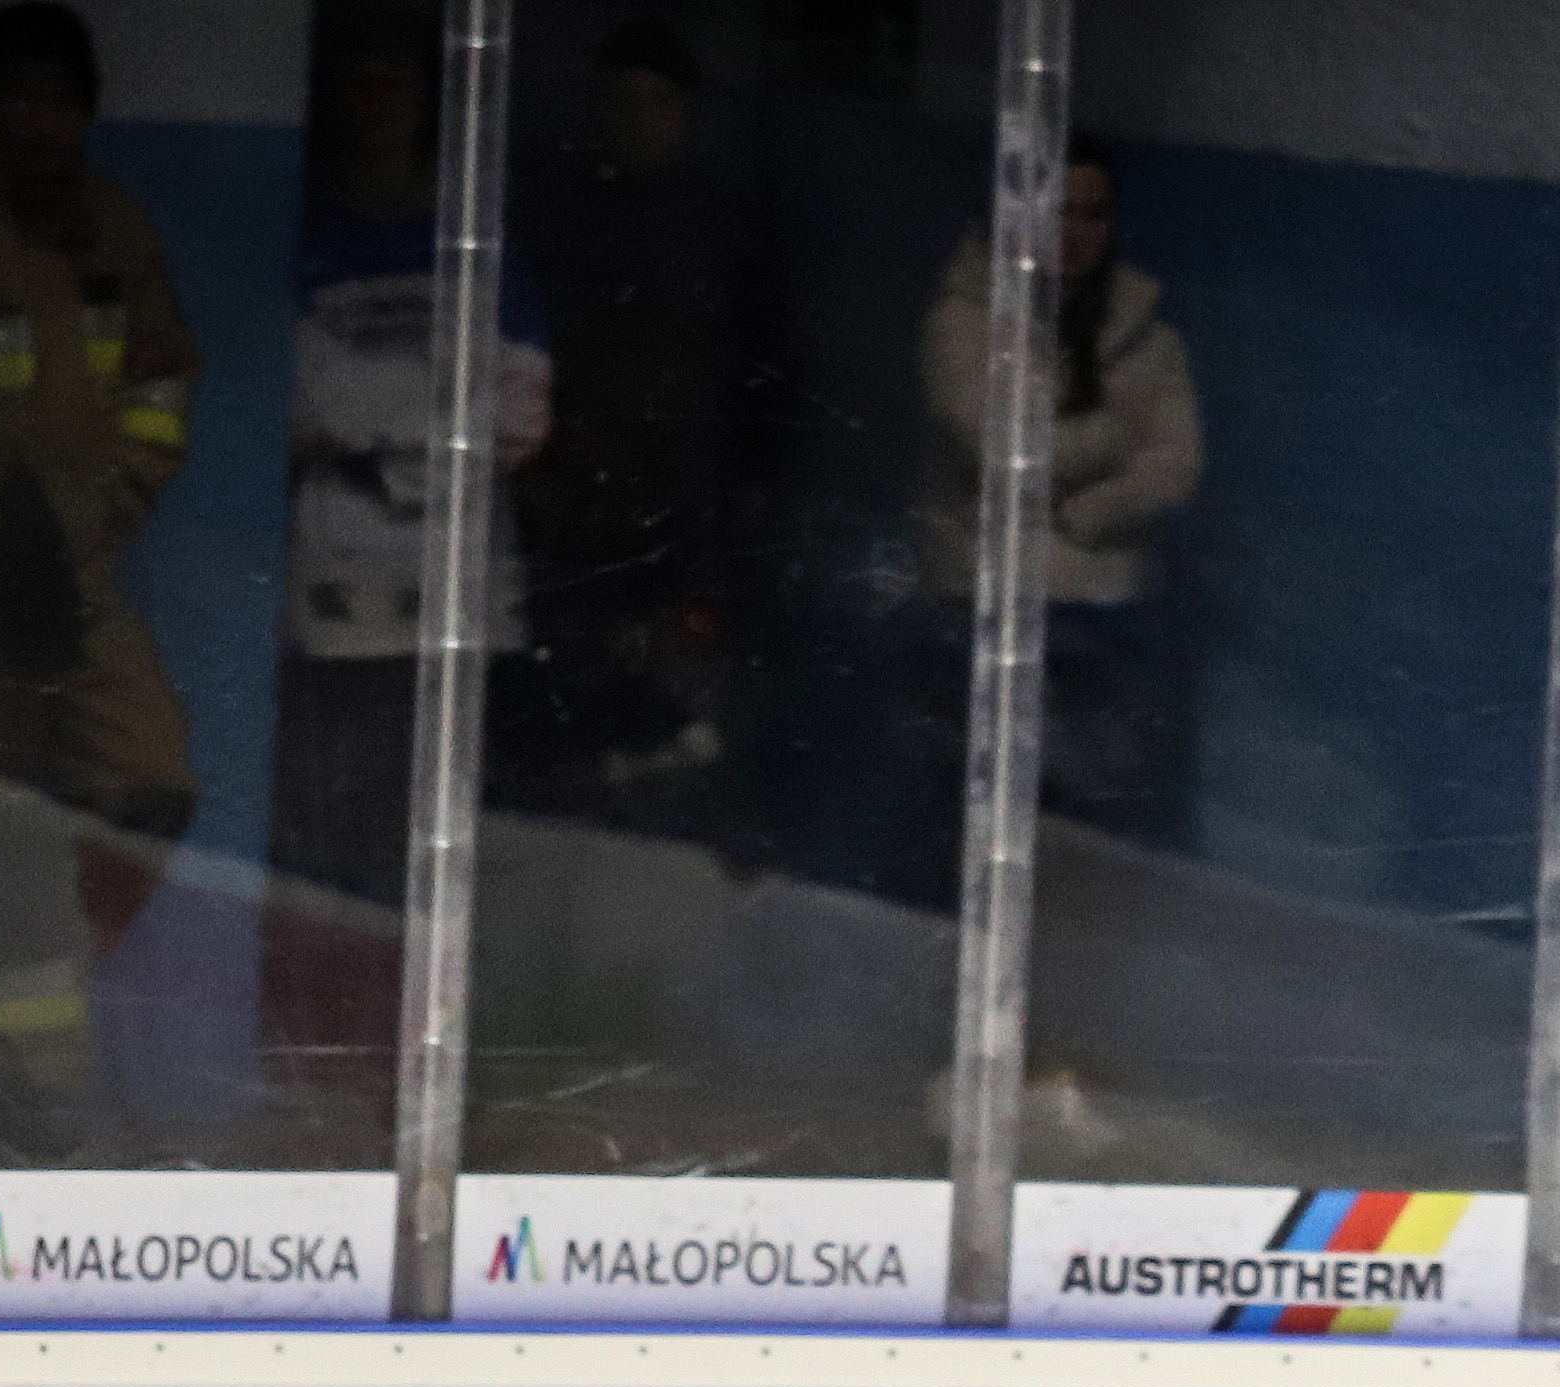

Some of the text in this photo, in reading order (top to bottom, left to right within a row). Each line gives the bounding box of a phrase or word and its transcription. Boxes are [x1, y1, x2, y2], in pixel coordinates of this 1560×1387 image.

[32, 1233, 360, 1284] MAŁOPOLSKA
[562, 1239, 907, 1288] MAŁOPOLSKA
[1059, 1254, 1443, 1303] AUSTROTHERM
